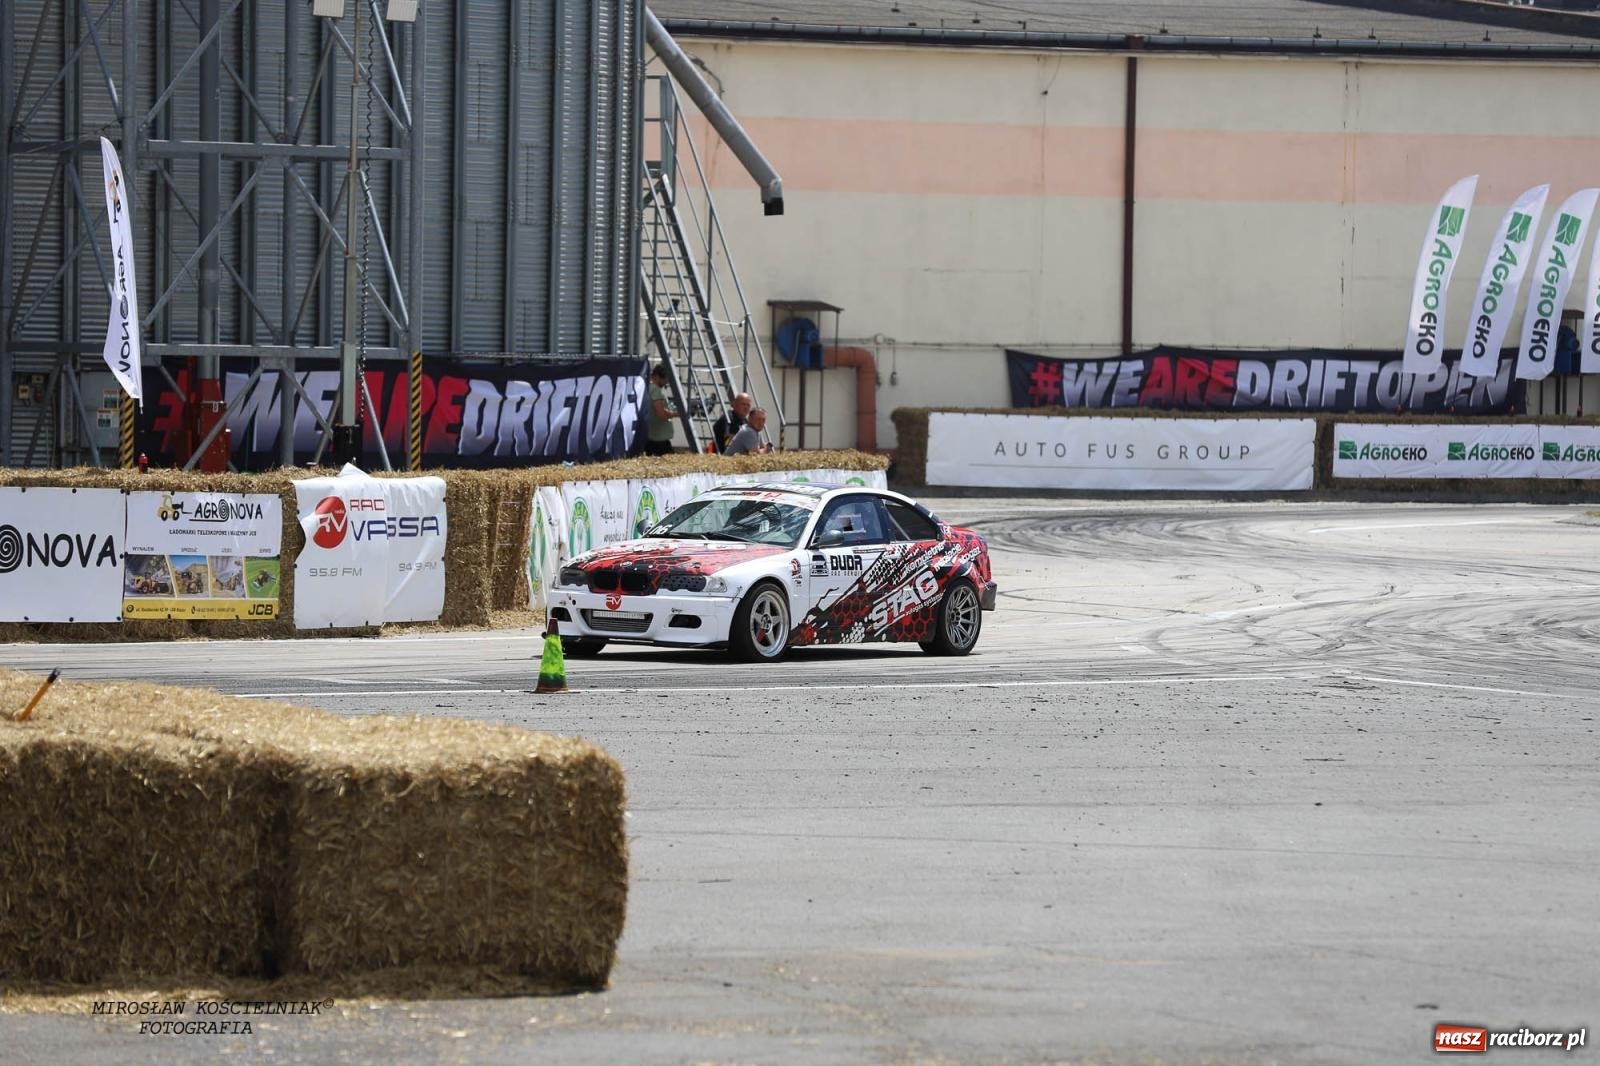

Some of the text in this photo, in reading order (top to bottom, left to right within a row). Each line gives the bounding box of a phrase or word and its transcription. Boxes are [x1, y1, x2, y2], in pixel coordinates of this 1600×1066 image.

[1416, 238, 1452, 356] AGROEKO
[1472, 243, 1518, 359] AGROEKO
[1528, 245, 1567, 362] AGROEKO
[995, 442, 1250, 460] AUTO FUS GROUP
[1359, 441, 1428, 461] AGROEKO
[1467, 442, 1535, 461] AGROEKO
[194, 499, 263, 521] AGRONOVA
[342, 568, 363, 576] FM
[830, 555, 863, 571] DUDA
[248, 604, 273, 615] JCB
[870, 570, 939, 630] STAG
